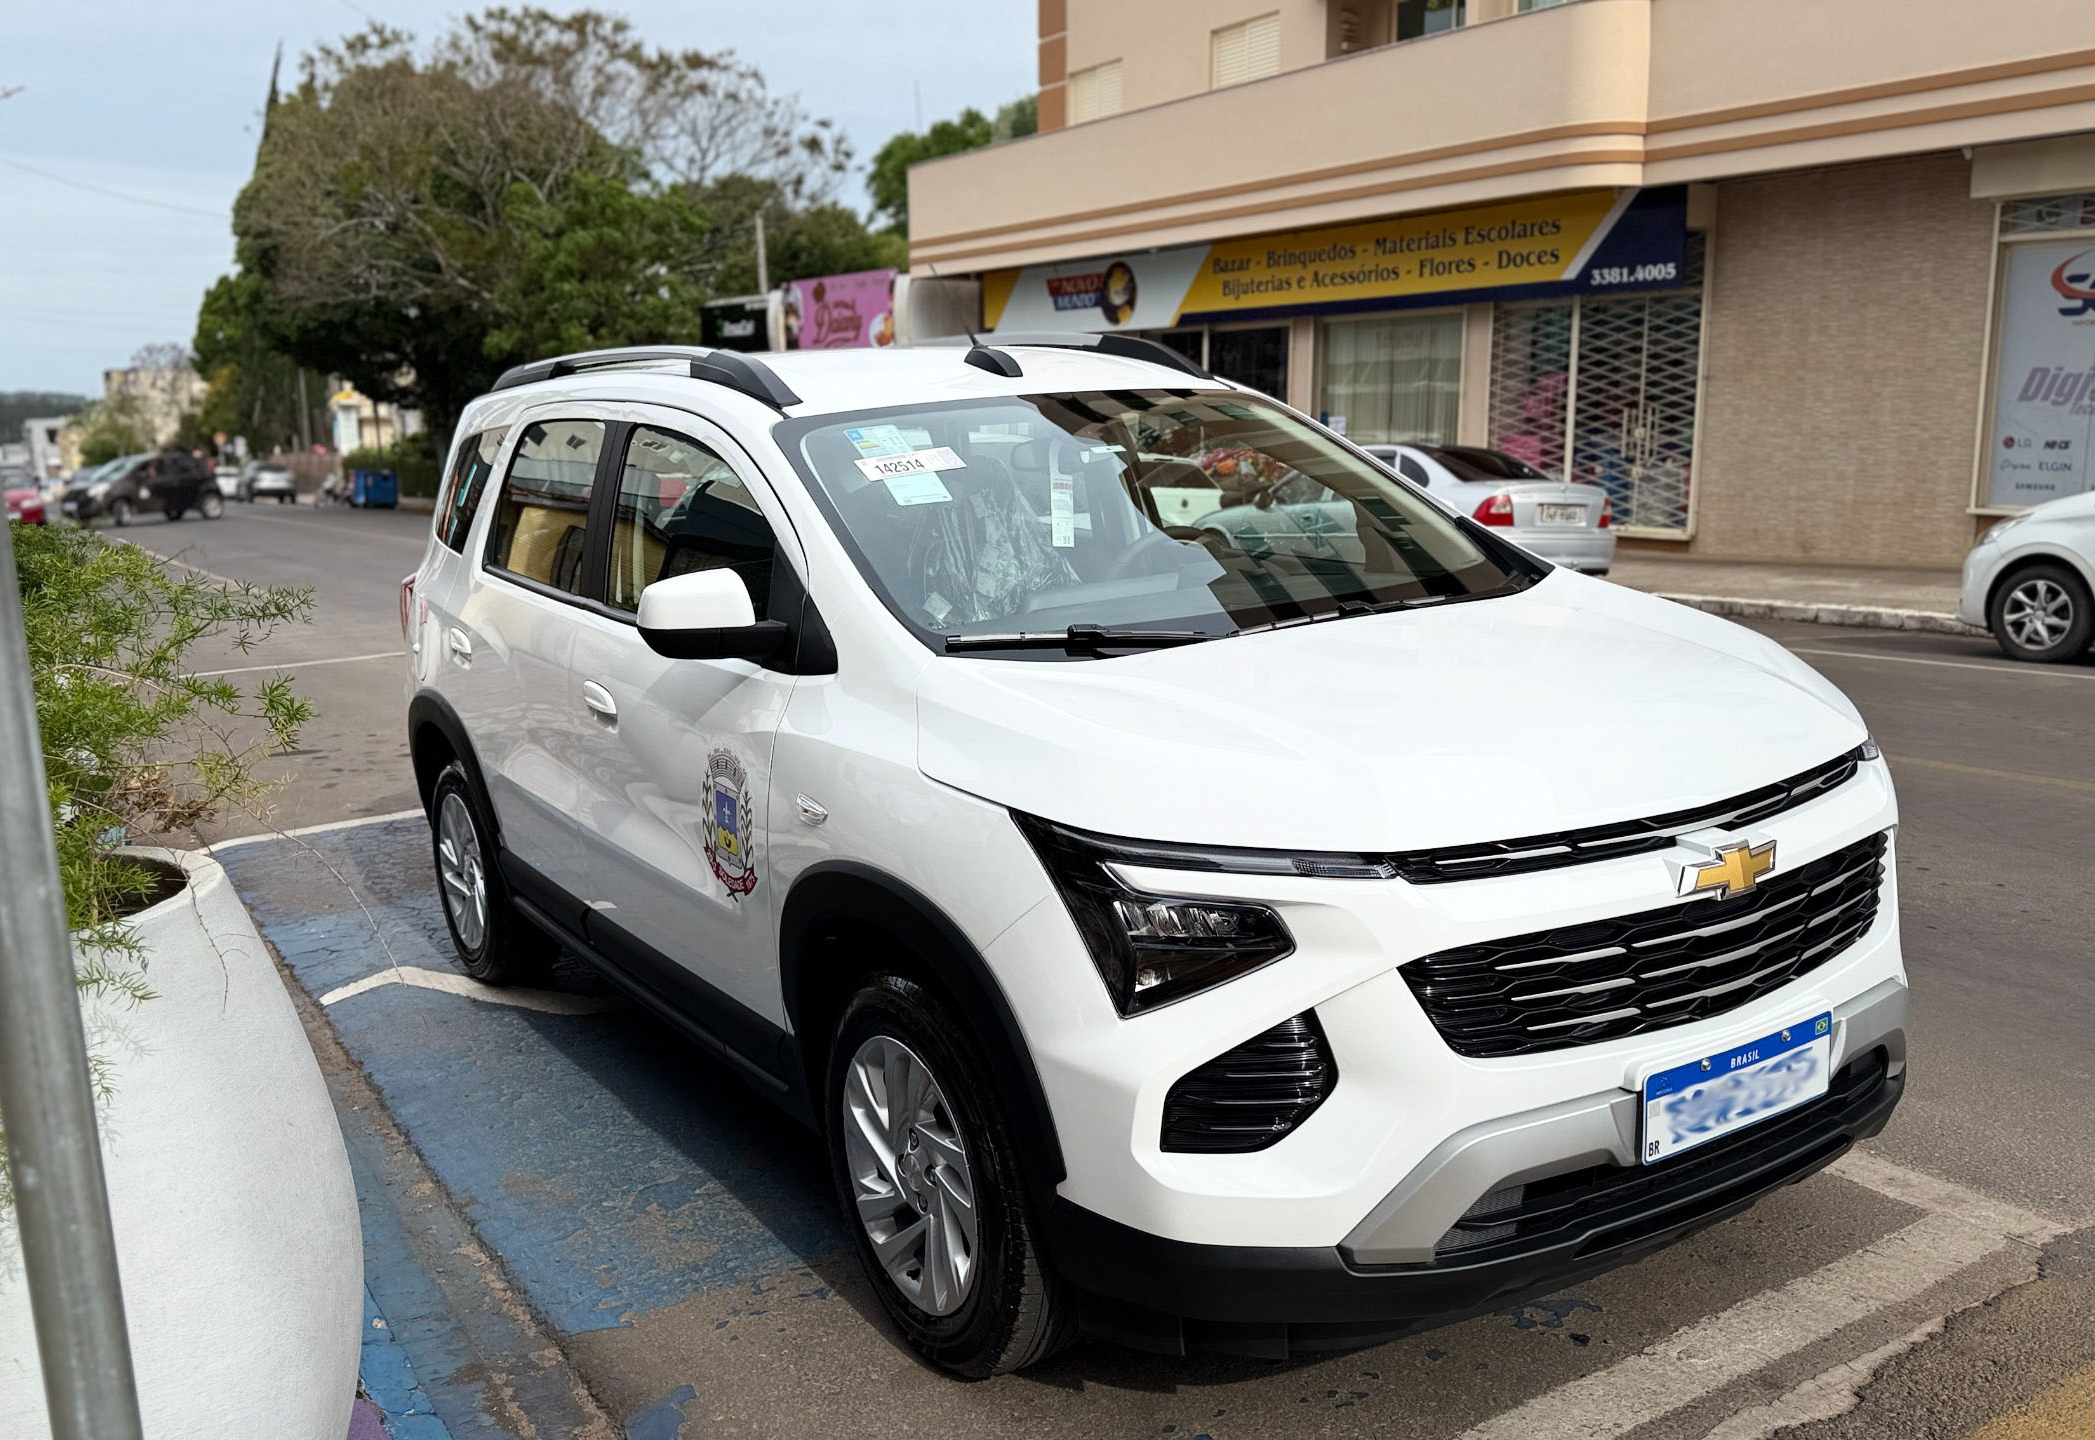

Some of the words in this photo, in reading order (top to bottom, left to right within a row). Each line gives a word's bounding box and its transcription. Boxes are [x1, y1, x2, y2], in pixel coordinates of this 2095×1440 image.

[1212, 256, 1251, 275] Bazar
[1266, 243, 1356, 269] Brinquedos
[1374, 228, 1457, 256] Materiais
[1463, 218, 1561, 246] Escolares
[1222, 273, 1292, 300] Bijuterias
[1297, 275, 1306, 289] e
[1310, 264, 1400, 289] Acessórios
[1418, 255, 1476, 278] Flores
[1497, 246, 1560, 270] Doces
[1590, 262, 1676, 286] 3381.4005
[875, 459, 925, 475] 142514
[1730, 1049, 1760, 1069] BRASIL
[1648, 1140, 1660, 1157] BR
